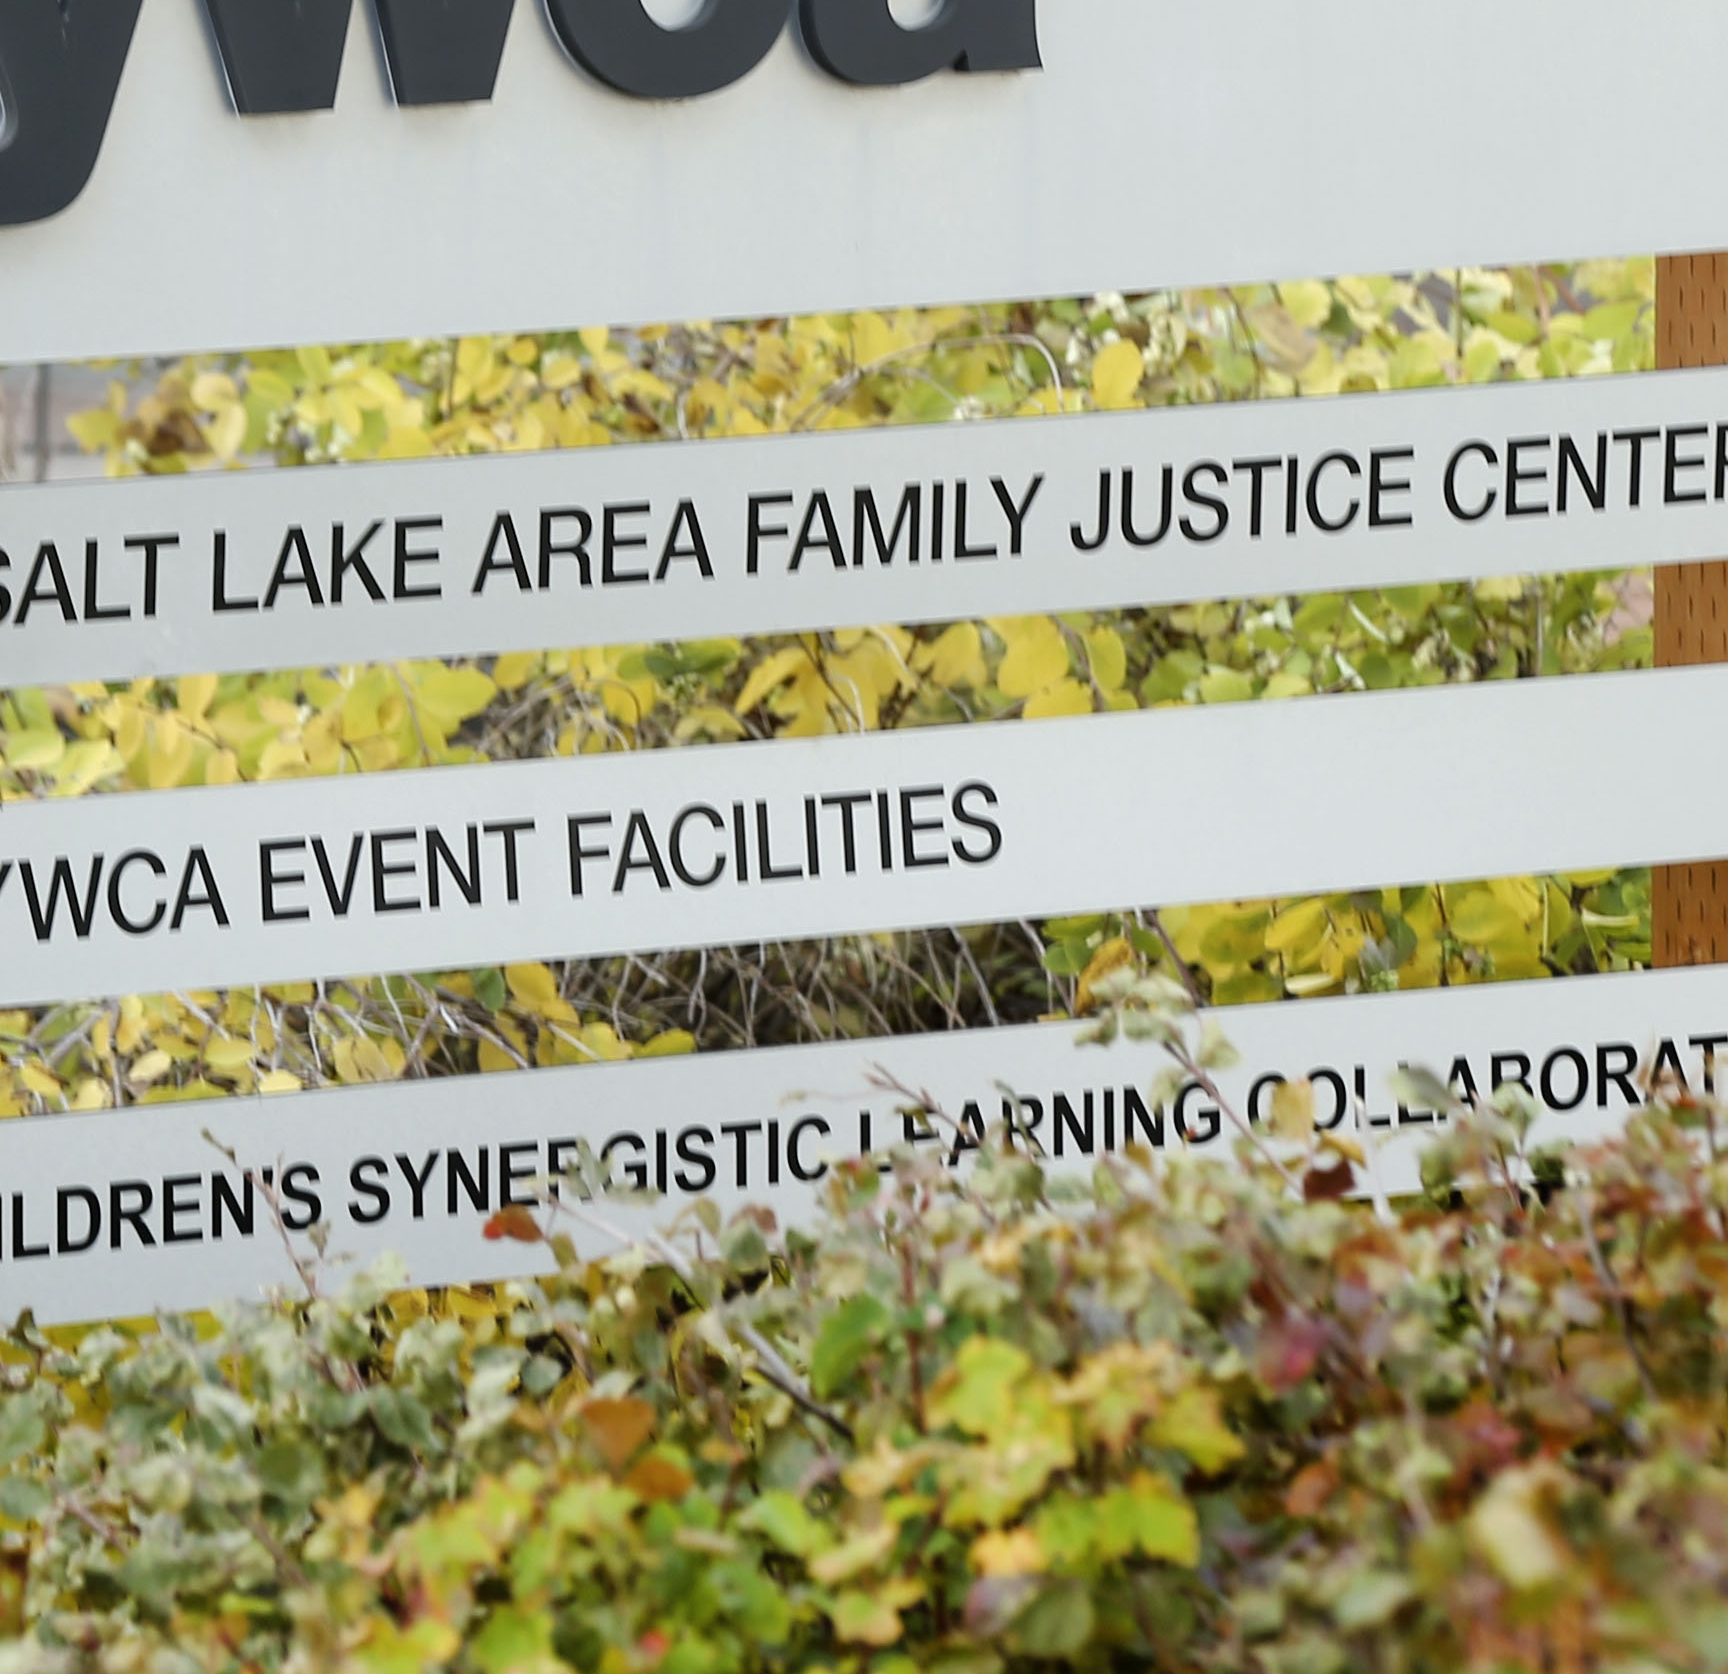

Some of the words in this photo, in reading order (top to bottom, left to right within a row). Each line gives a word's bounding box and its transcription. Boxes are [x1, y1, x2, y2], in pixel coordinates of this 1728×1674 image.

[211, 516, 444, 614] LAKE
[470, 498, 715, 595] AREA
[745, 474, 1044, 576] FAMILY
[1069, 447, 1415, 552] JUSTICE
[258, 819, 537, 924] EVENT
[566, 782, 1003, 897] FACILITIES
